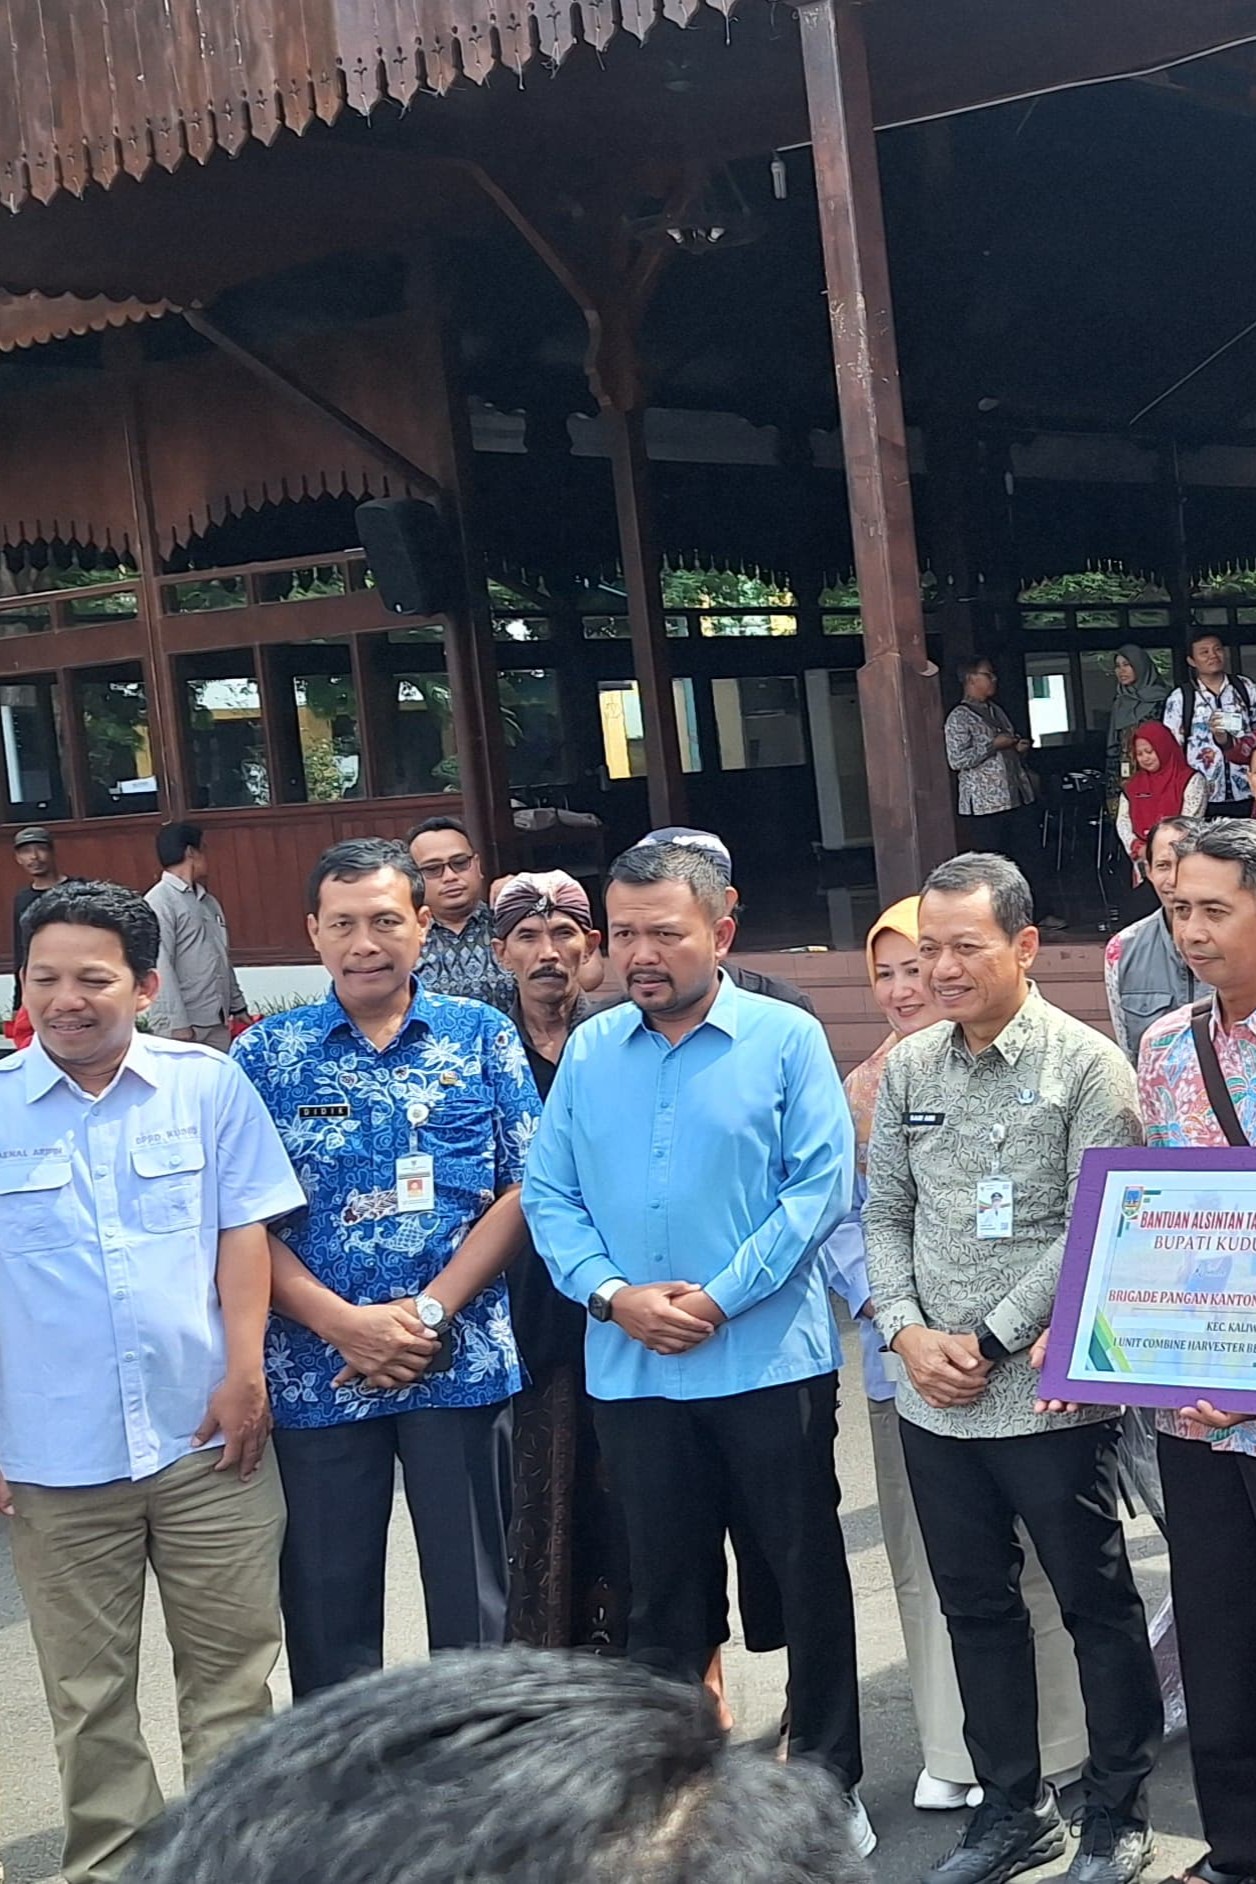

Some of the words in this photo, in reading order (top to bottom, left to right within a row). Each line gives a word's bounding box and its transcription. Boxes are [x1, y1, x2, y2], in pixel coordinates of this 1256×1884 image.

[303, 1107, 344, 1116] DIDIK
[1140, 1211, 1188, 1229] BANTUAN
[1191, 1211, 1244, 1230] ALSINTAN
[1154, 1235, 1211, 1250] BUPATI
[1108, 1289, 1158, 1304] BRIGADE
[1159, 1290, 1208, 1305] PANGAN
[1118, 1336, 1142, 1348] UNIT
[1142, 1338, 1186, 1351] COMBINE
[1187, 1340, 1245, 1353] HARVESTER
